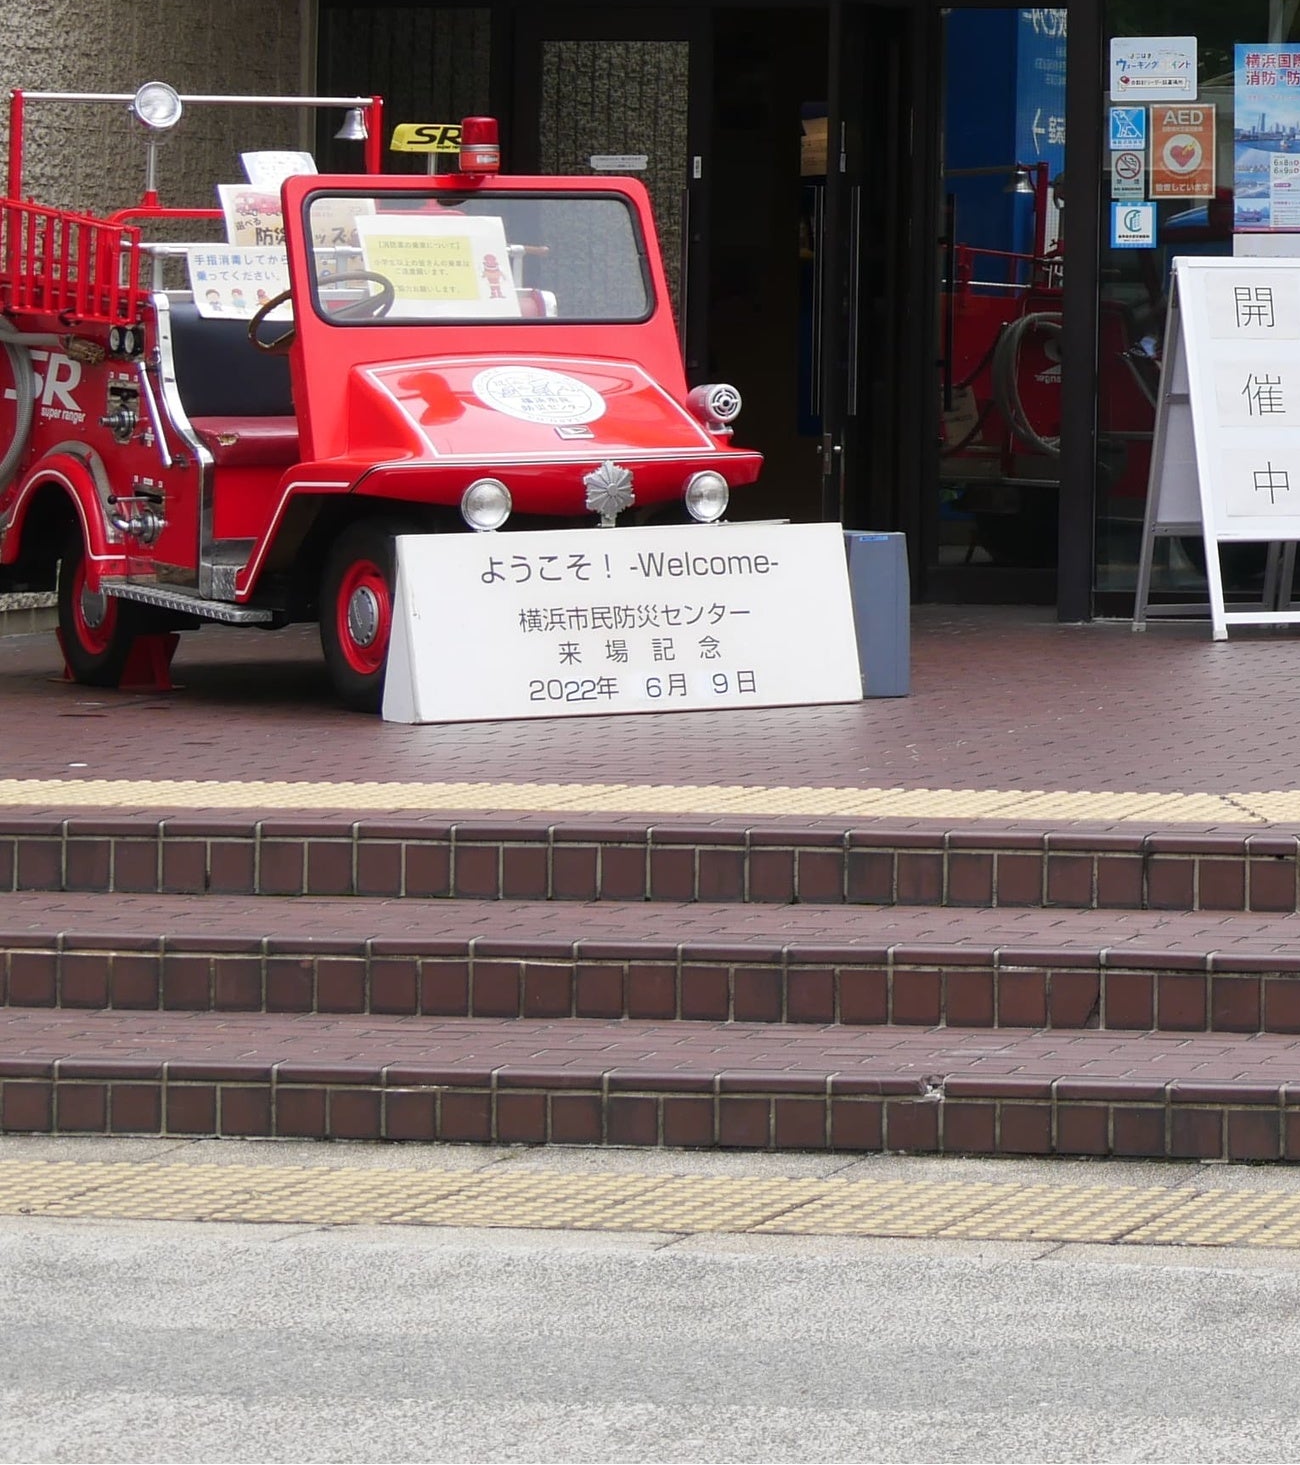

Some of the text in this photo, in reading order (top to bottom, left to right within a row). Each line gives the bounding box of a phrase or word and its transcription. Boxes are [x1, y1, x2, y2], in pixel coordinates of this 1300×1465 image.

[1116, 58, 1191, 72] ウォーキングイント
[1163, 110, 1203, 126] AED
[1233, 286, 1290, 505] 開催中
[481, 553, 612, 584] ようこそ！
[518, 602, 751, 634] 横浜市民防災センター
[529, 675, 619, 702] 2022年
